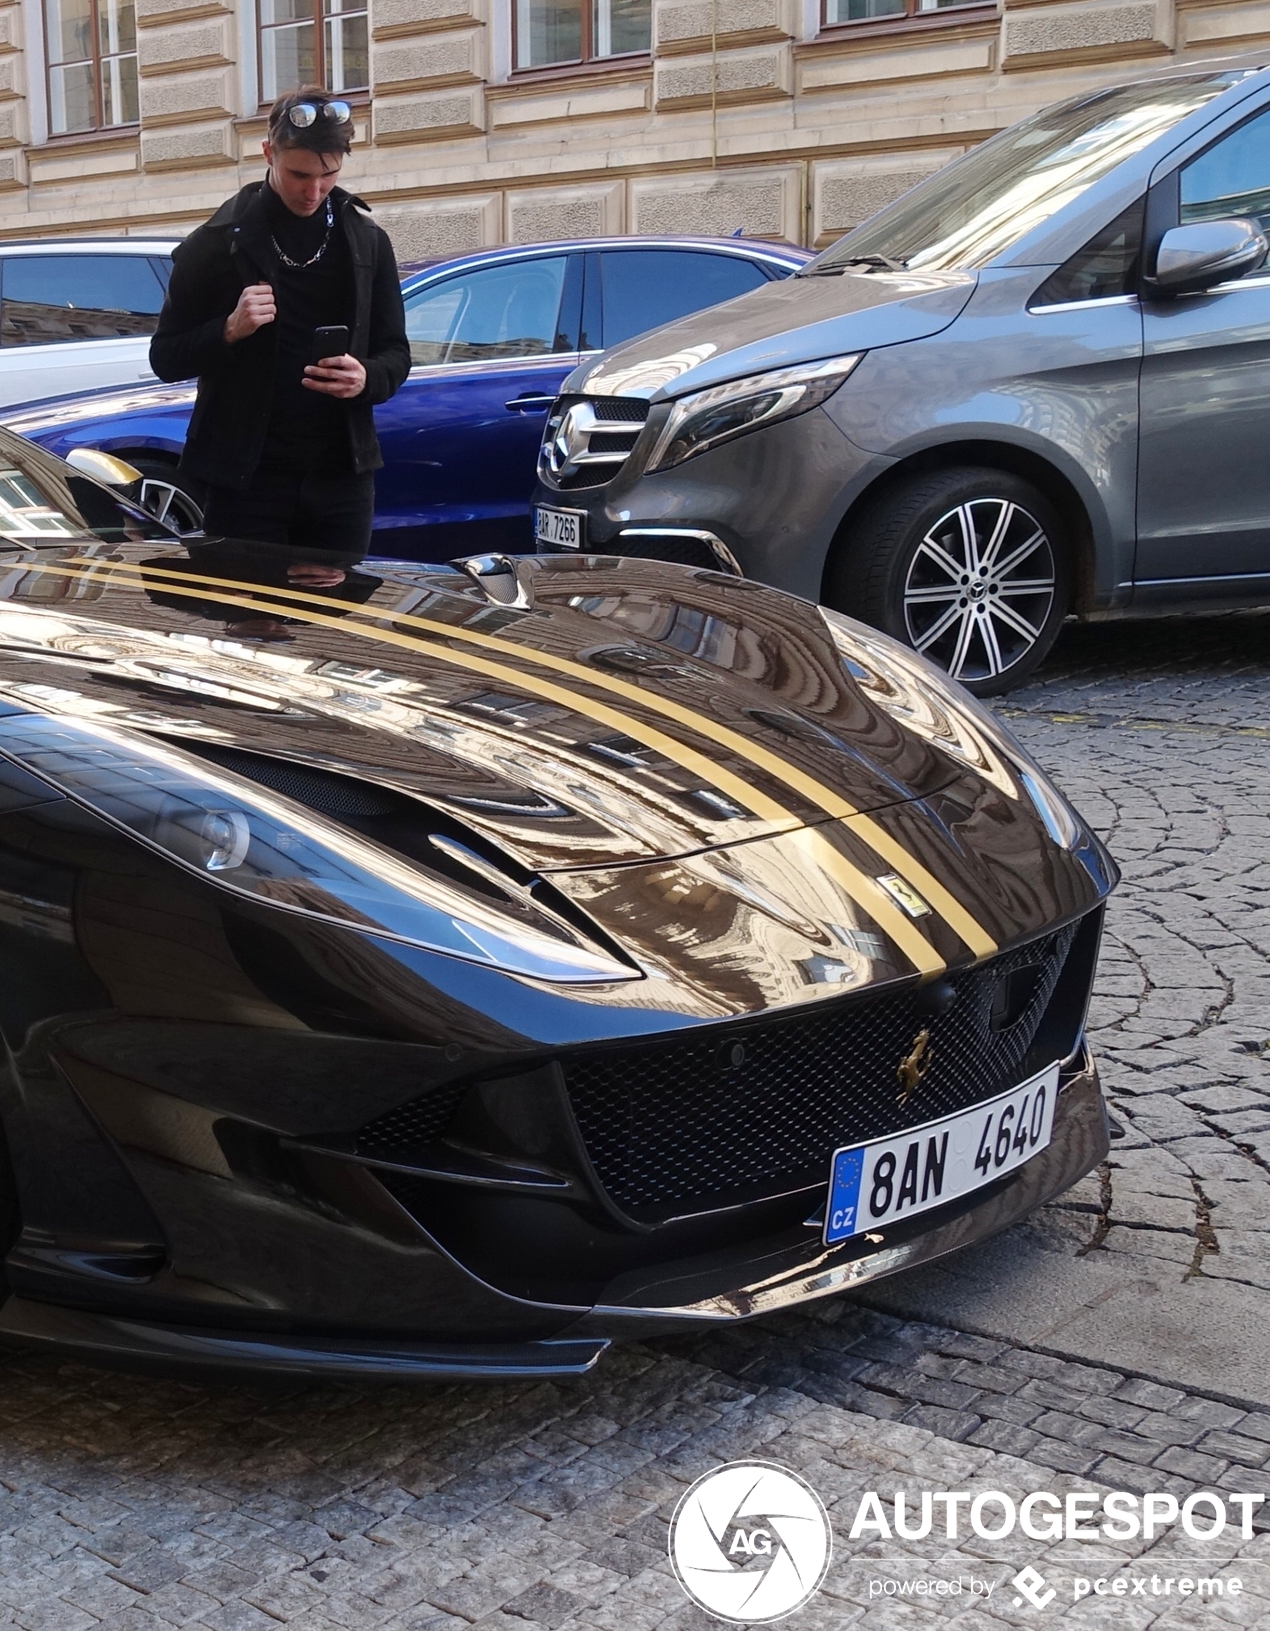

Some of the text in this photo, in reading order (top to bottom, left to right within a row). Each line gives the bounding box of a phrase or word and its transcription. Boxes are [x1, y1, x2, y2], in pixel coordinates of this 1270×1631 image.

[554, 515, 575, 542] 7266
[869, 1085, 1046, 1218] 8AN 4640
[832, 1206, 854, 1230] CZ
